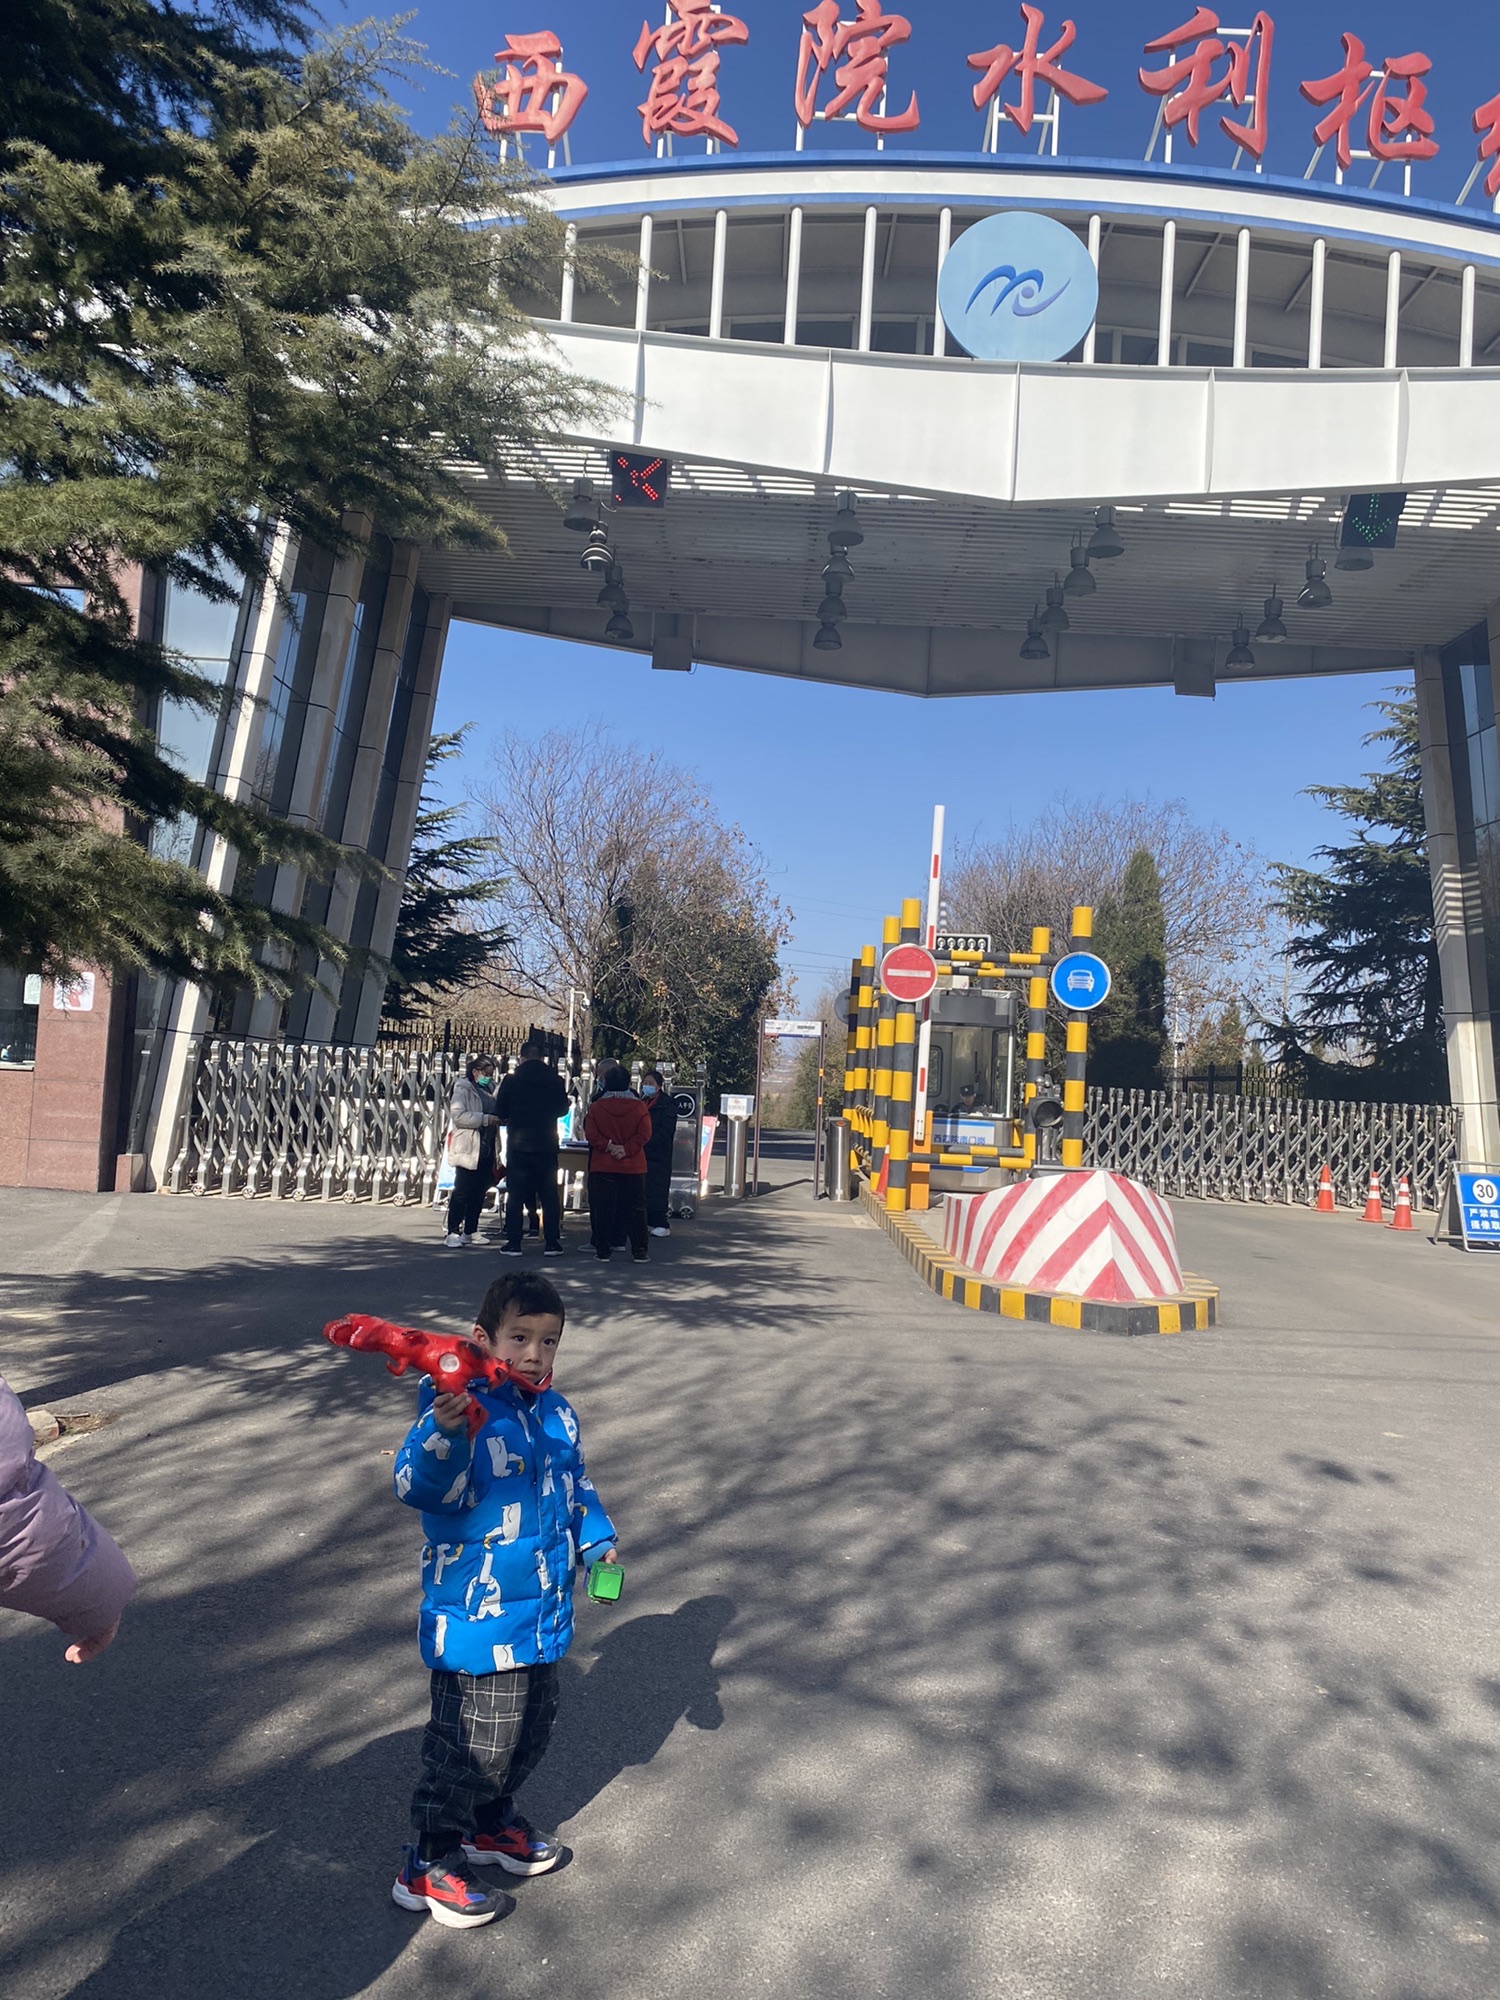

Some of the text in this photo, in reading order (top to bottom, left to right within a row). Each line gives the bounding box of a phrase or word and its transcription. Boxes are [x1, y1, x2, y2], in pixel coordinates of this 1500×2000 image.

[473, 0, 1500, 198] 西霞院水利枢
[1476, 1184, 1494, 1198] 30
